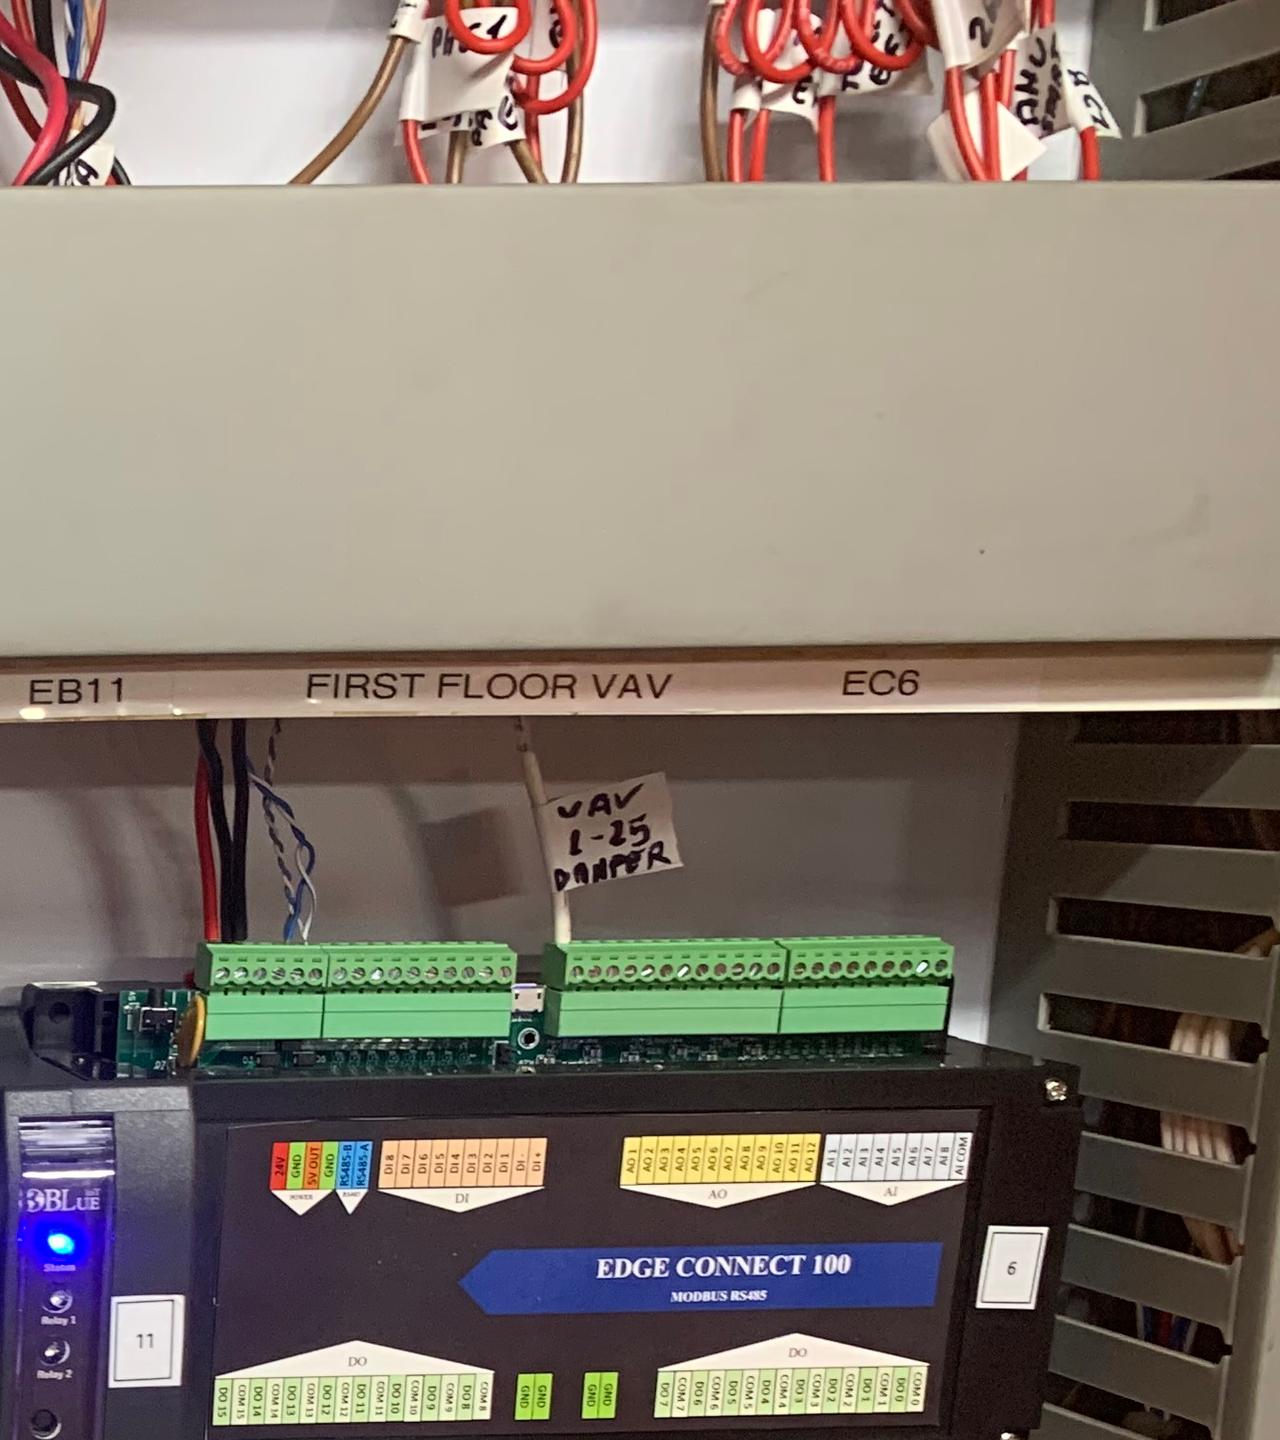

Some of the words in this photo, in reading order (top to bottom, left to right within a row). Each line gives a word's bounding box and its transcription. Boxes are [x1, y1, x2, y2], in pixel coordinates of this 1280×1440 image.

[306, 672, 426, 700] FIRST
[437, 672, 578, 700] FLOOR
[591, 673, 674, 699] VAV
[842, 668, 921, 696] EC6
[29, 676, 123, 705] EB11
[557, 783, 644, 818] VAV
[554, 840, 671, 892] DAMPER
[710, 1189, 727, 1199] AO
[884, 1187, 898, 1196] AI
[456, 1193, 469, 1203] DI
[597, 1258, 669, 1278] EDGE
[676, 1255, 806, 1277] CONNECT
[813, 1254, 851, 1274] 100
[1008, 1262, 1016, 1275] 6
[671, 1291, 728, 1302] MODBUS
[731, 1290, 767, 1300] RS485
[41, 1316, 67, 1326] Relay
[136, 1333, 153, 1348] 11
[789, 1348, 807, 1358] DO
[349, 1357, 367, 1367] DO
[37, 1370, 63, 1379] Relay
